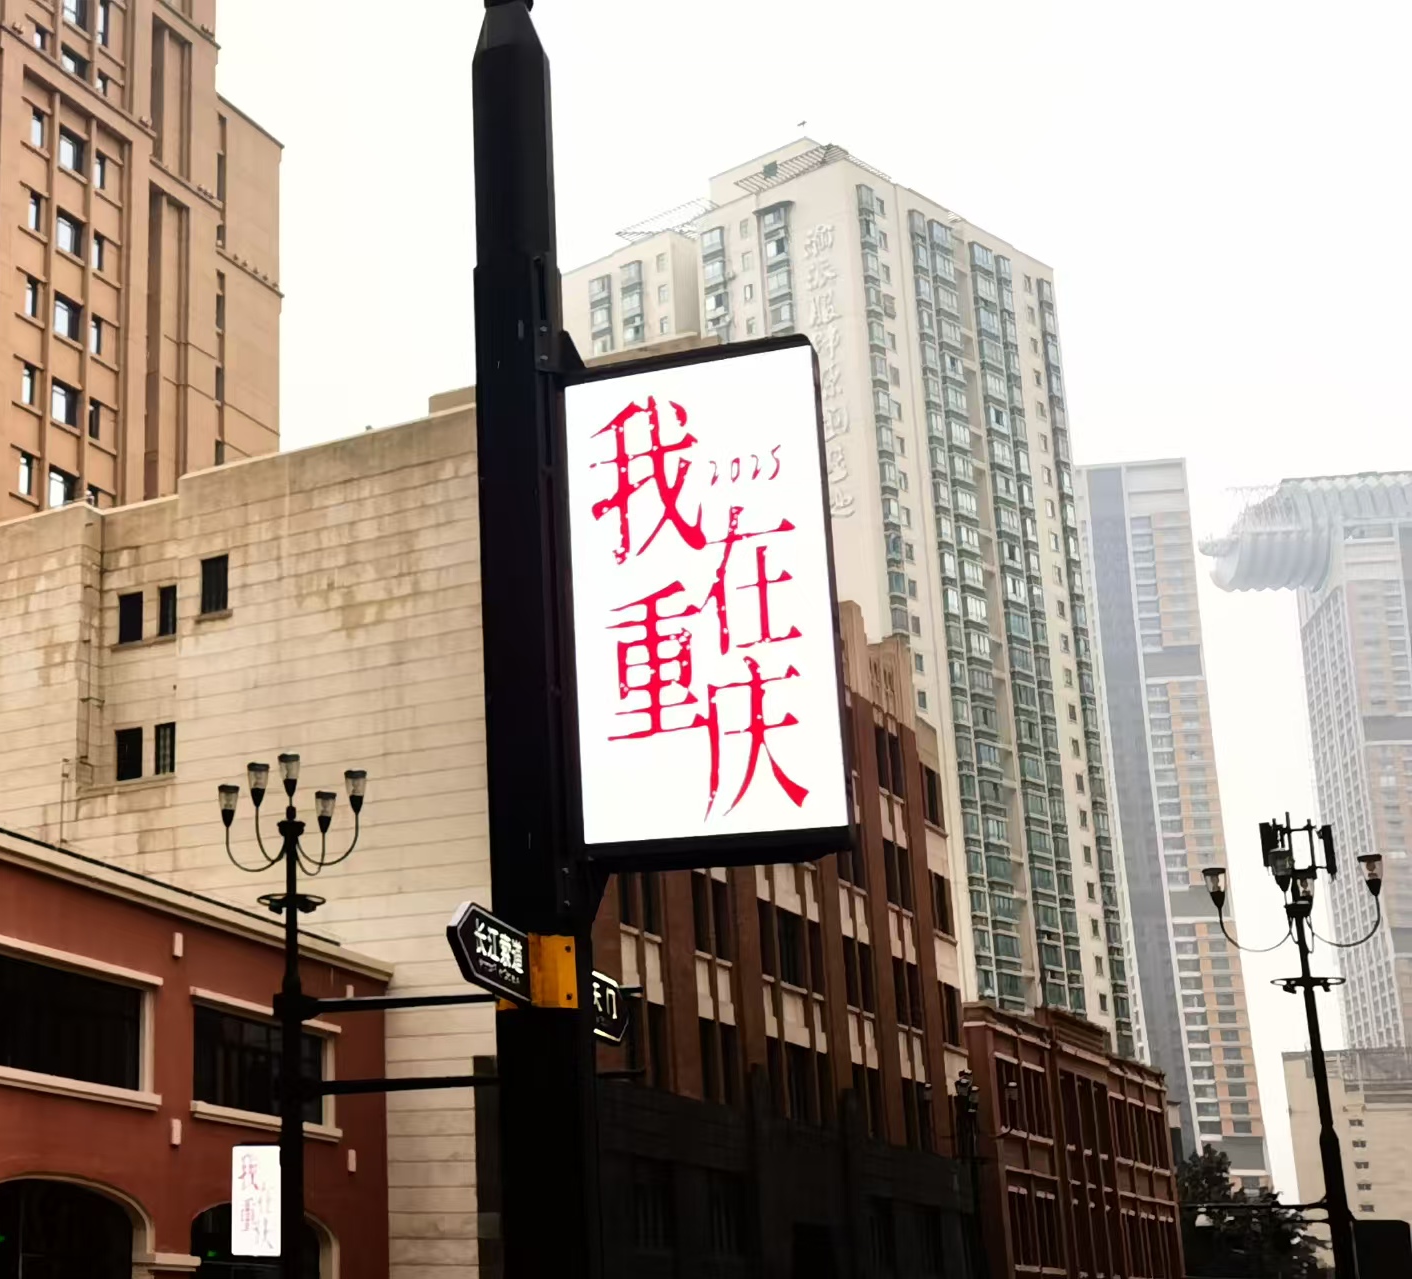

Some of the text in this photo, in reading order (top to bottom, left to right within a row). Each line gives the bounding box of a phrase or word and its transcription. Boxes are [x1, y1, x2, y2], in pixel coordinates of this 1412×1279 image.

[708, 444, 782, 487] 2025
[474, 917, 525, 975] 长江索道
